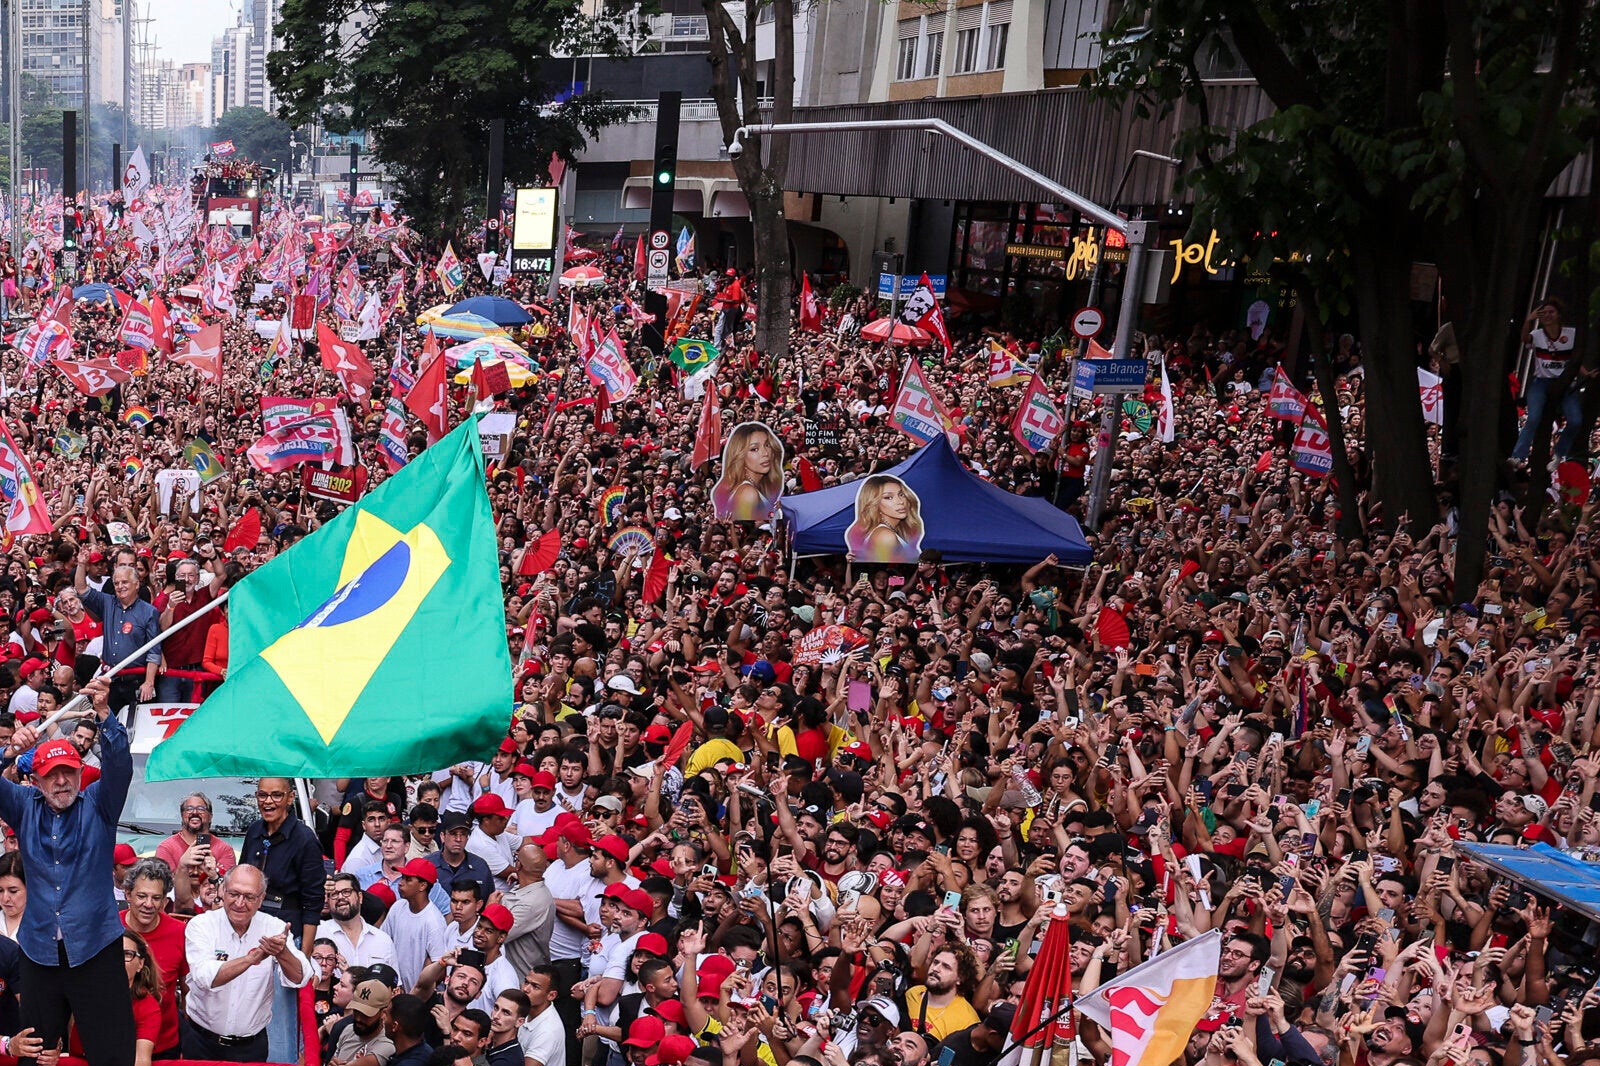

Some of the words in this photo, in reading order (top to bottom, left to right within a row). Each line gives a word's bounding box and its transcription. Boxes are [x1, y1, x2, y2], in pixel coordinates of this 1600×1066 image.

[654, 235, 667, 244] 50
[515, 258, 545, 271] 16:47
[902, 278, 919, 287] Casa
[927, 277, 945, 286] anca
[1096, 365, 1108, 375] sa
[1109, 363, 1145, 375] Branca
[806, 421, 819, 431] HÁ
[818, 437, 839, 445] TÚNEL
[312, 472, 330, 482] LUNA
[328, 476, 352, 492] 1302
[801, 629, 823, 647] LULA
[47, 750, 67, 760] SILVA
